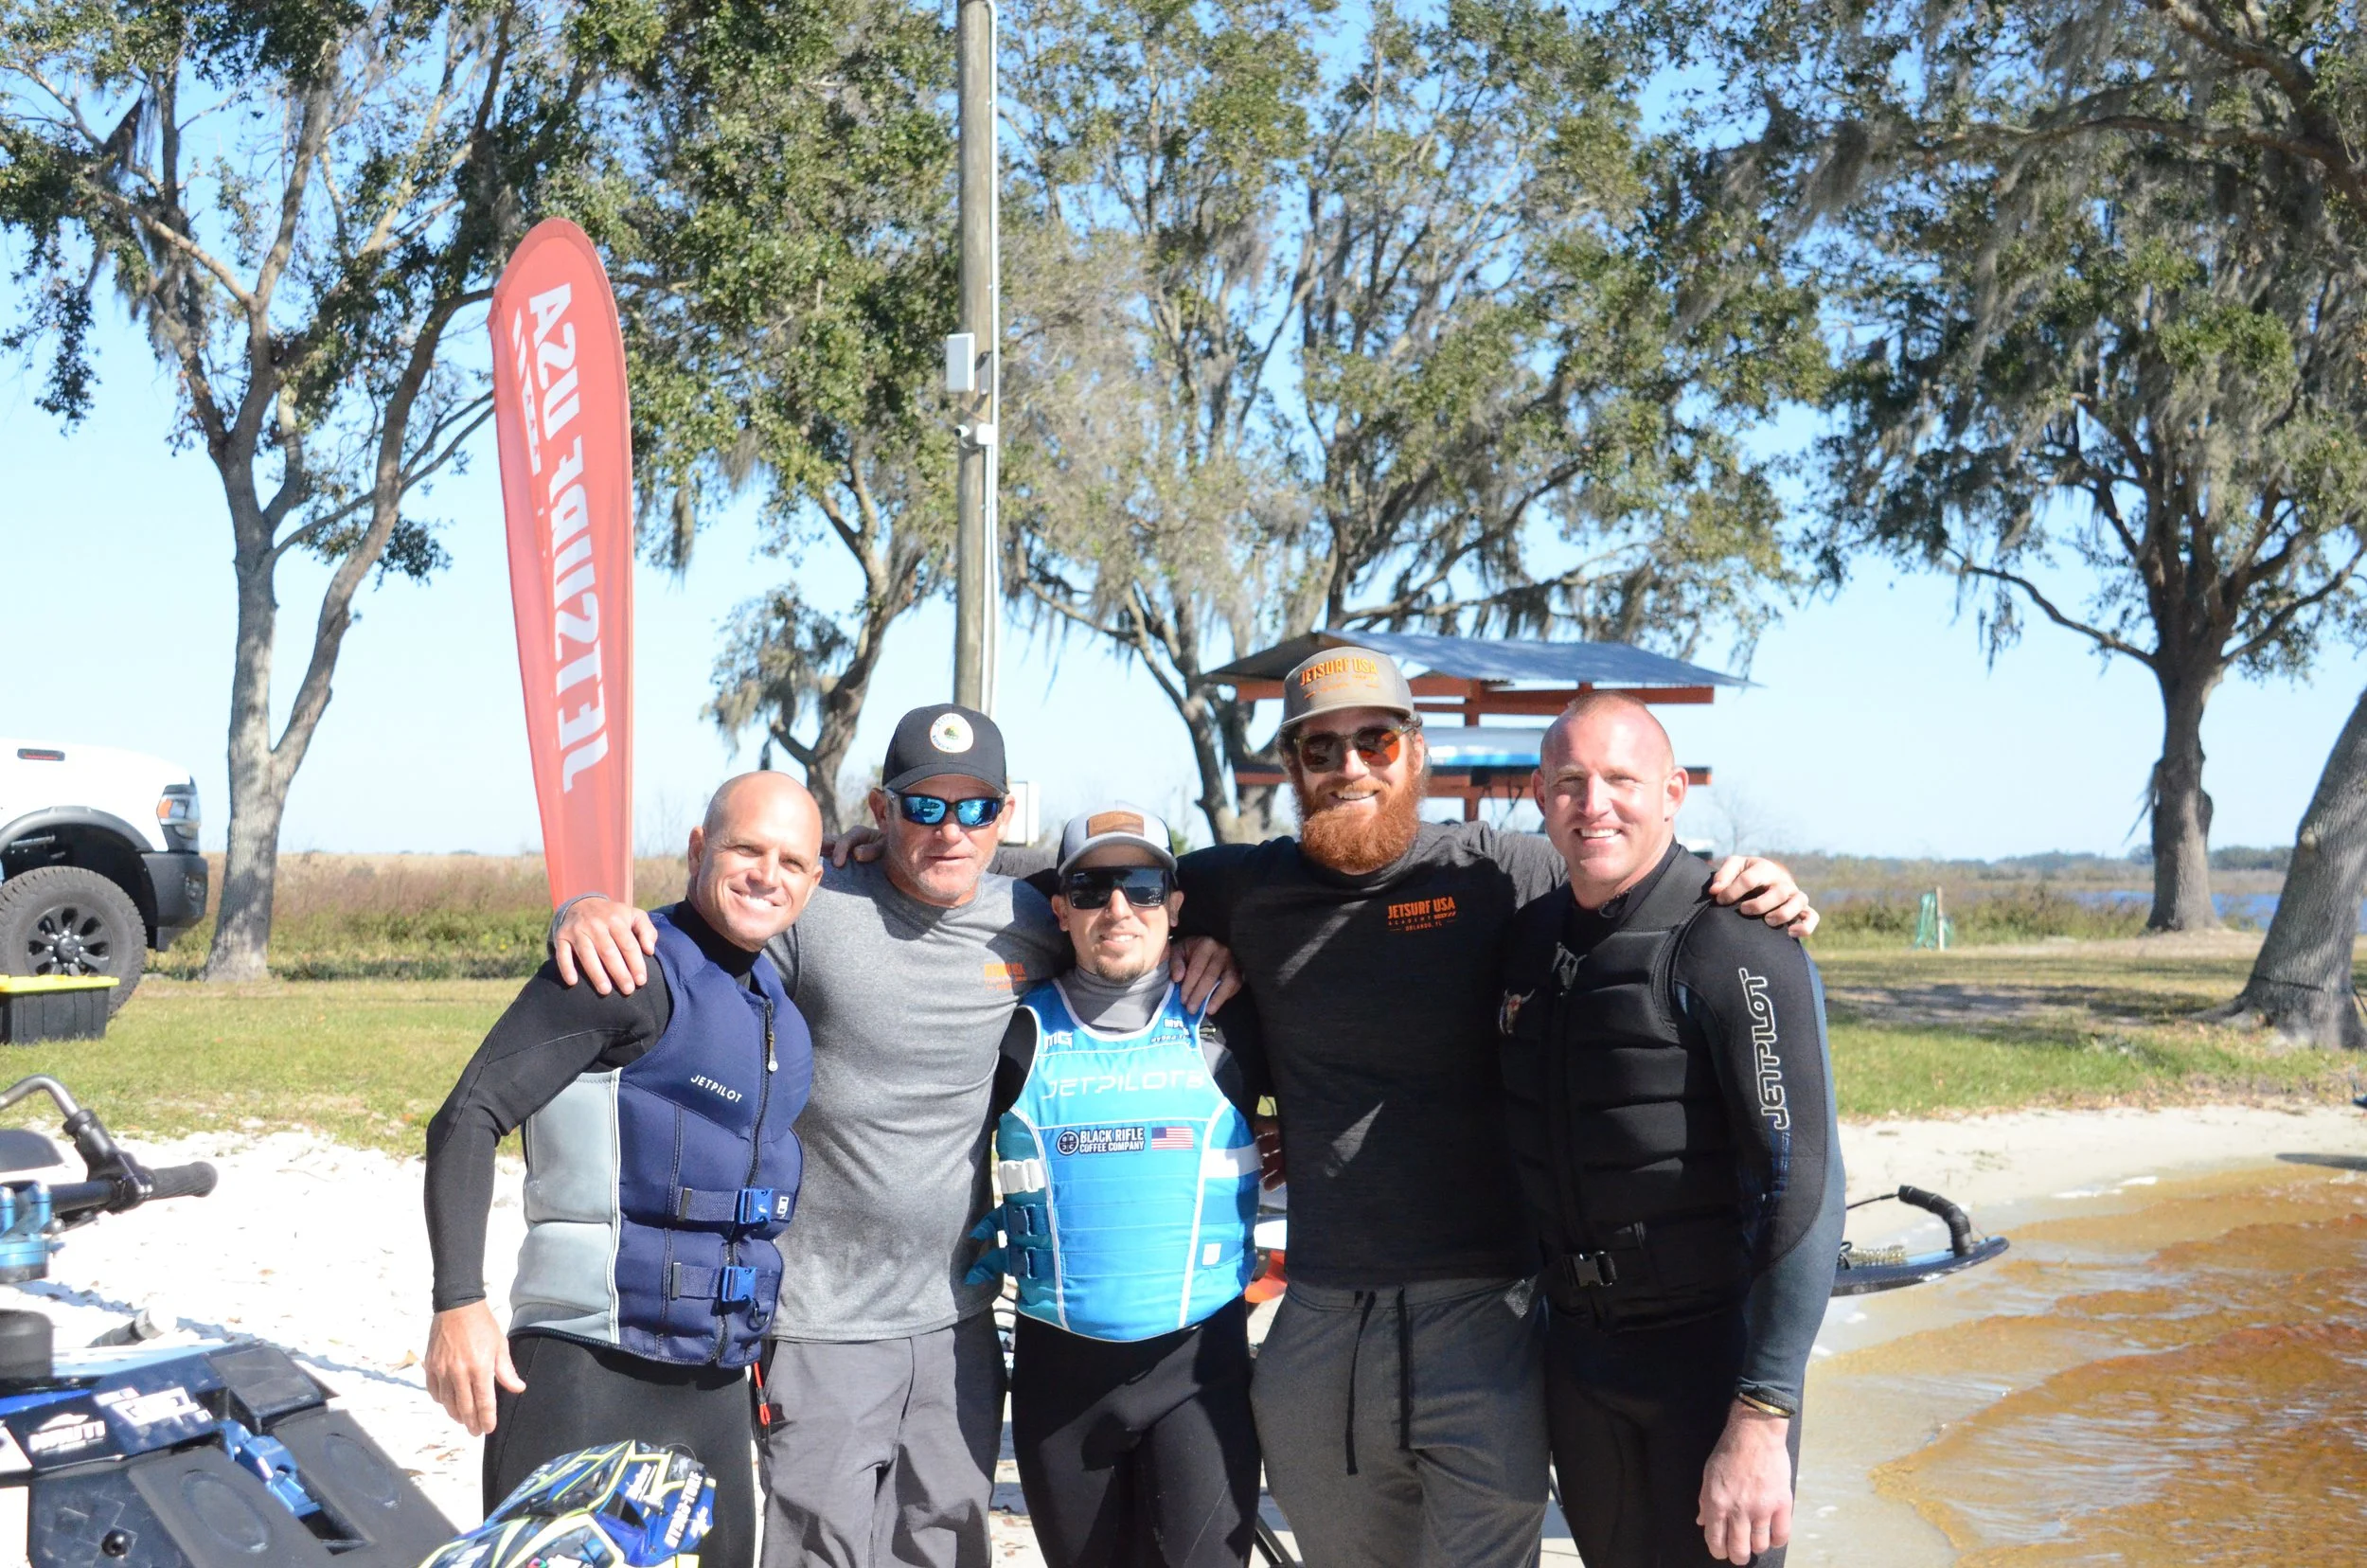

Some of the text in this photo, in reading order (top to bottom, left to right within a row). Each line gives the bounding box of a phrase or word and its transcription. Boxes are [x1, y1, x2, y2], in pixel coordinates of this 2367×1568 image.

[1300, 658, 1348, 686] JETSURF
[1352, 657, 1378, 674] USA
[1388, 900, 1431, 919] JETSURF
[1433, 896, 1455, 912] USA
[1738, 968, 1789, 1130] JETPILOT
[690, 1075, 742, 1103] JETPILOT
[1079, 1127, 1144, 1144] BLACK RIFLE
[1079, 1140, 1144, 1153] COFFEE COMPANY
